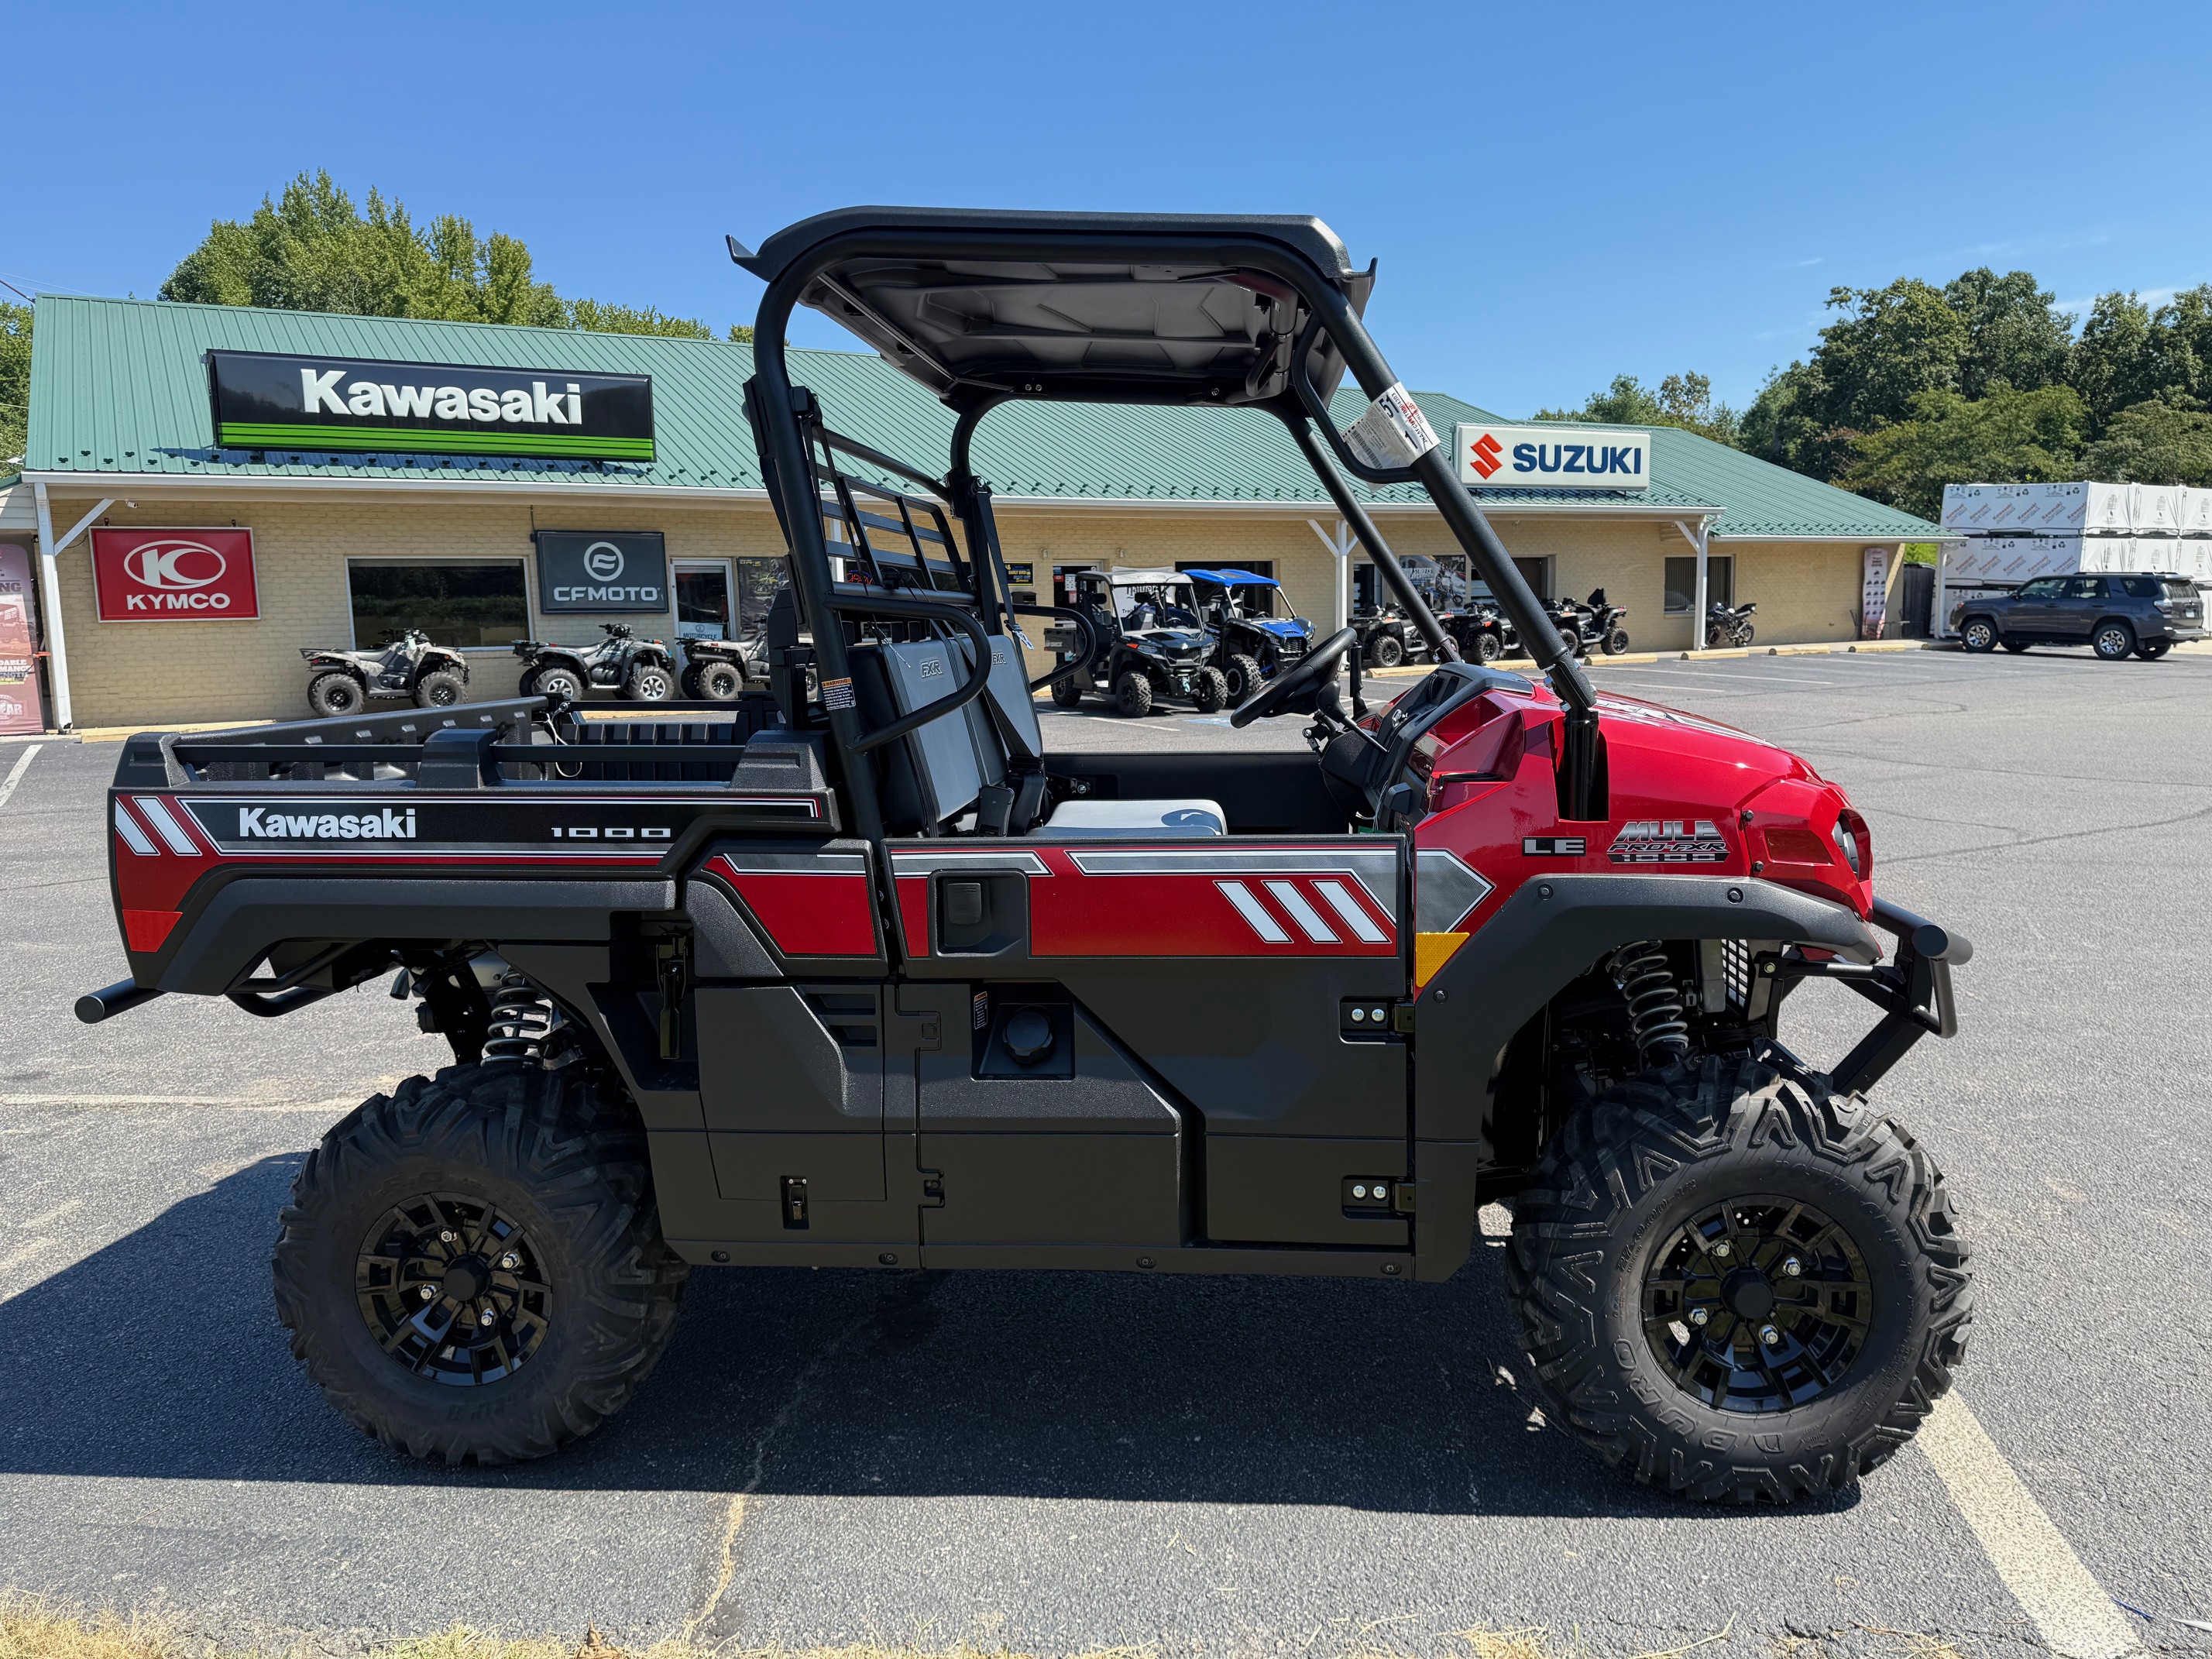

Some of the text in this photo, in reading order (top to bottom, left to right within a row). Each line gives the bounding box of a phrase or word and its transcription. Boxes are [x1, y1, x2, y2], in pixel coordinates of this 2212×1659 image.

[301, 369, 582, 424] Kawasaki
[1513, 443, 1641, 474] SUZUKI
[126, 592, 231, 610] KYMCO
[553, 586, 658, 601] CFMOTO
[920, 660, 943, 678] FXR
[239, 807, 417, 839] Kawasaki
[1613, 821, 1725, 842] MULE
[551, 827, 672, 838] 1000
[1524, 839, 1585, 854] LE
[1607, 842, 1727, 853] PRO-FXR
[1622, 853, 1716, 861] 1000
[1613, 1338, 1739, 1452] DURO
